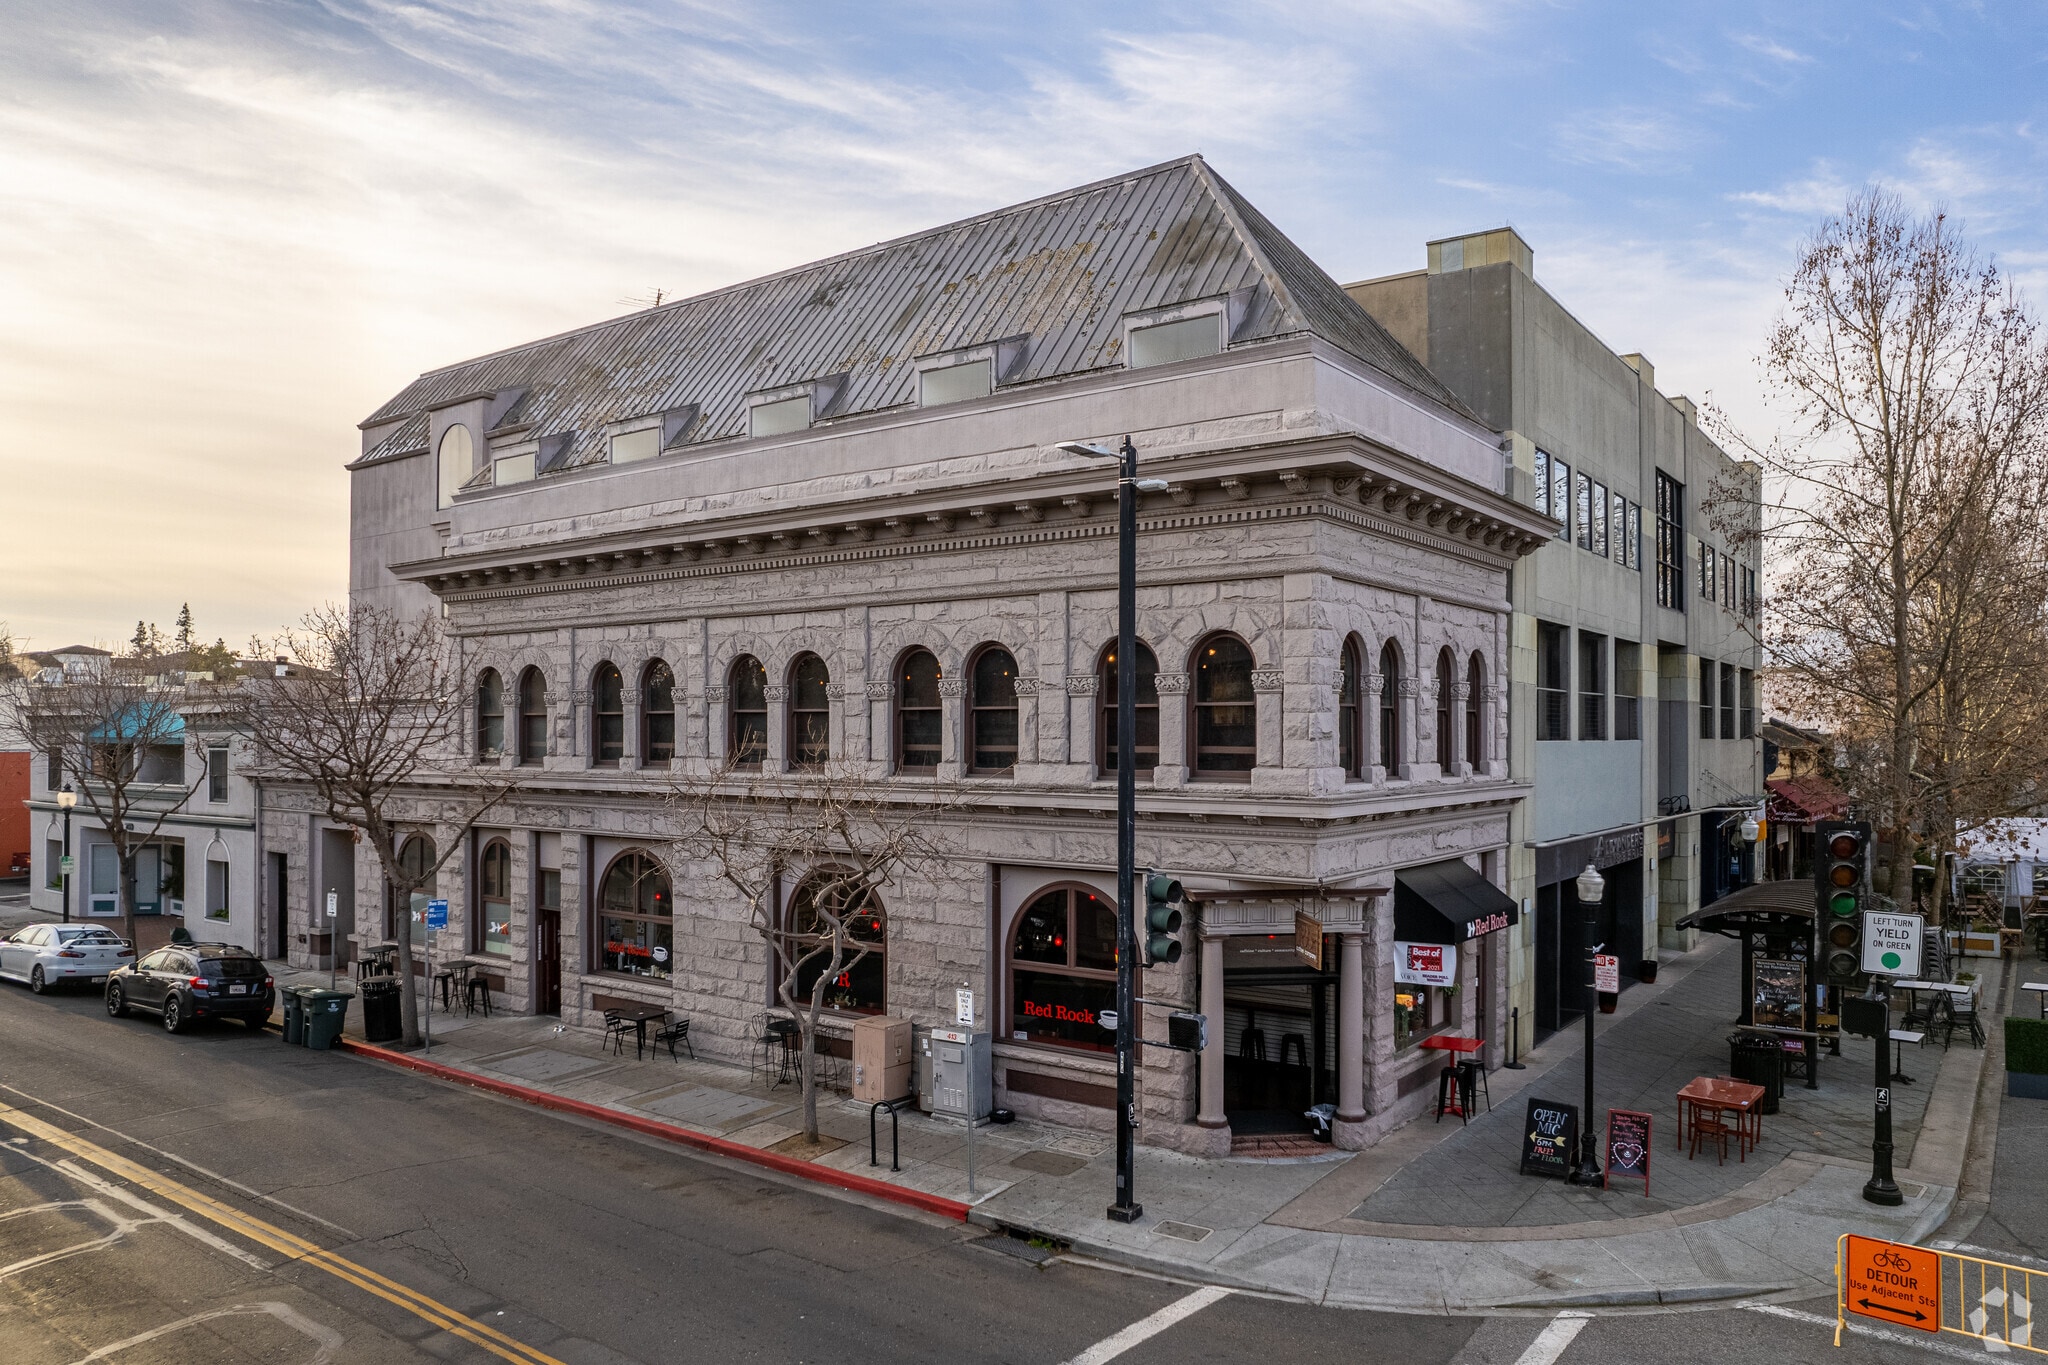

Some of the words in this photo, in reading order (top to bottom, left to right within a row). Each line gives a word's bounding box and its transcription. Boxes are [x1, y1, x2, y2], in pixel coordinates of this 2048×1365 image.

[1475, 915, 1490, 936] Red
[1490, 911, 1508, 931] Rock
[1873, 917, 1891, 926] LEFT
[1892, 918, 1913, 928] TURN
[1876, 927, 1909, 940] YIELD
[1873, 940, 1884, 948] ON
[1886, 941, 1911, 950] GREEN
[1412, 947, 1431, 957] Best
[1431, 948, 1441, 957] of
[1596, 956, 1605, 965] NO
[1024, 1000, 1053, 1018] Red
[1055, 1005, 1095, 1024] Rock
[1533, 1108, 1568, 1126] OPEN
[1536, 1121, 1561, 1136] MIC
[1536, 1138, 1553, 1148] 6PM
[1533, 1146, 1555, 1156] FREE!
[1541, 1154, 1564, 1165] FLOOR
[1866, 1267, 1918, 1290] DETOUR
[1849, 1279, 1868, 1291] Use
[1871, 1284, 1914, 1302] Adjacent
[1918, 1295, 1936, 1308] Sts
